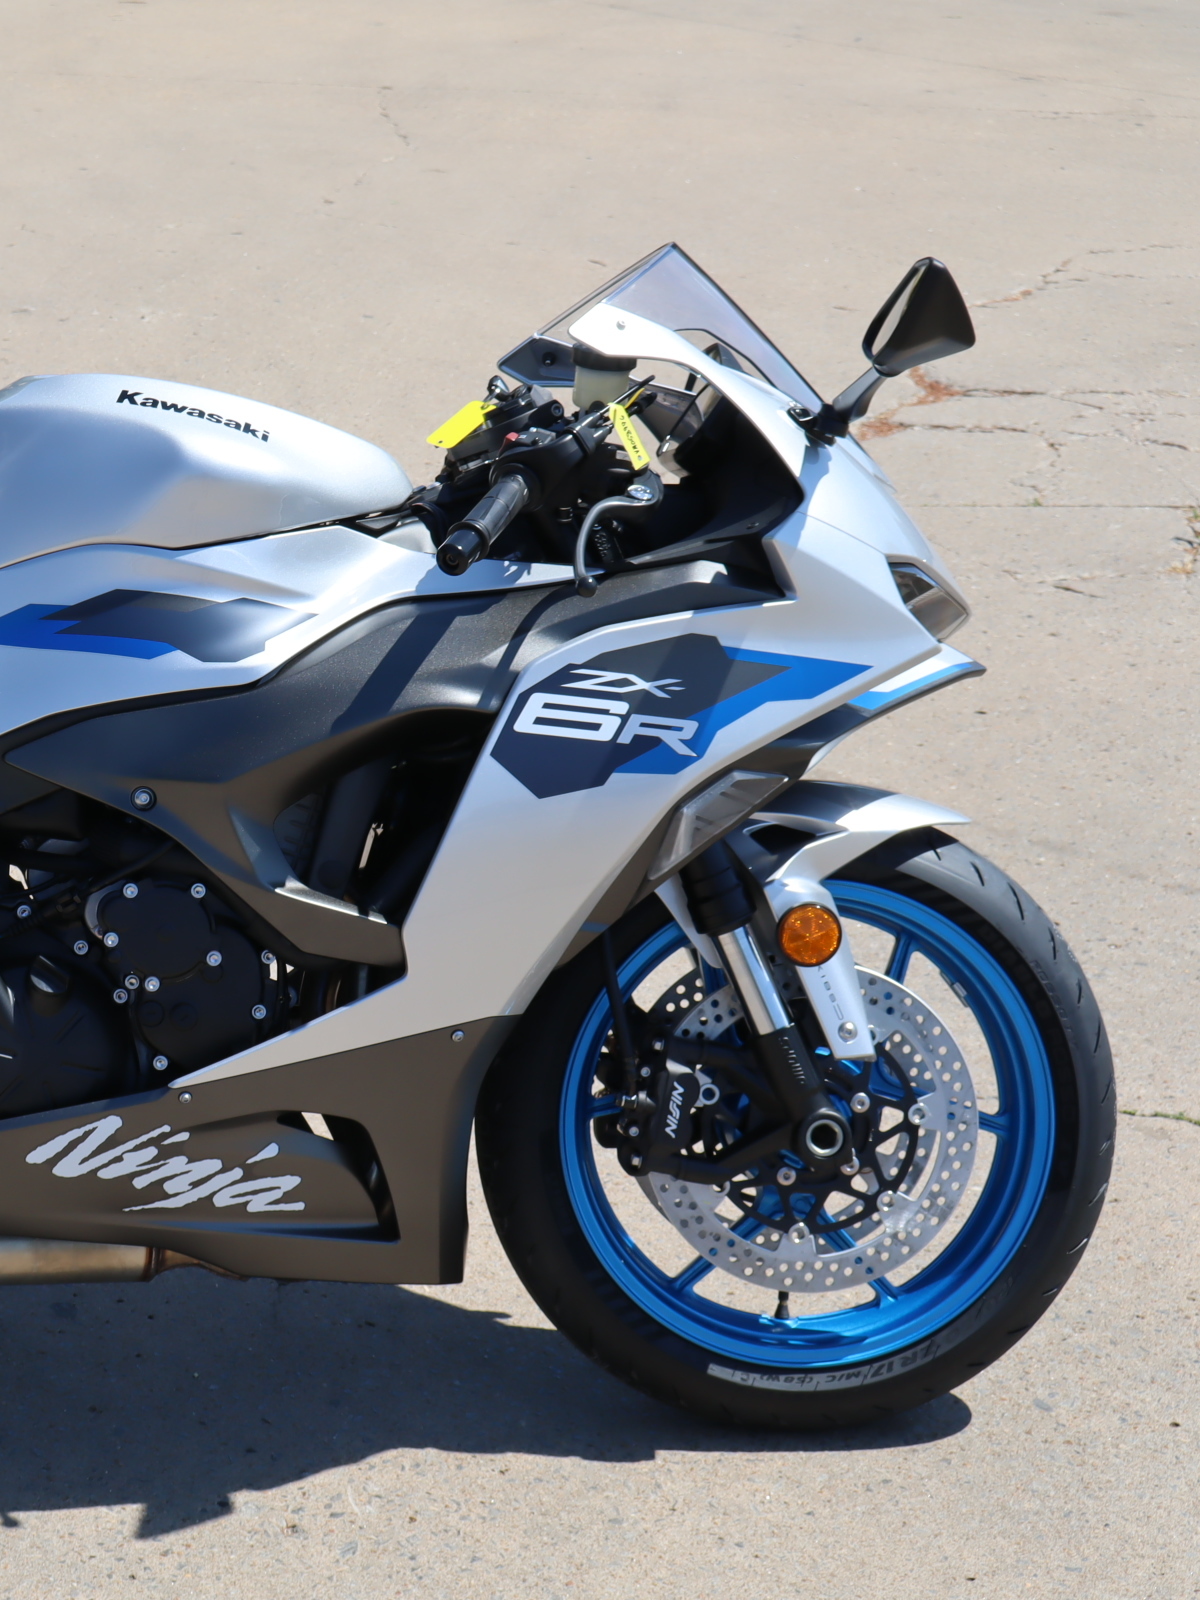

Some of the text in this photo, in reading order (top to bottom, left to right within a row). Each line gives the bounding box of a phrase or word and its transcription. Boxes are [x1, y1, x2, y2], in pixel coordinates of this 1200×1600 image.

[116, 389, 270, 442] Kawasaki
[664, 1080, 685, 1139] NISSIN
[25, 1114, 305, 1213] Ninja
